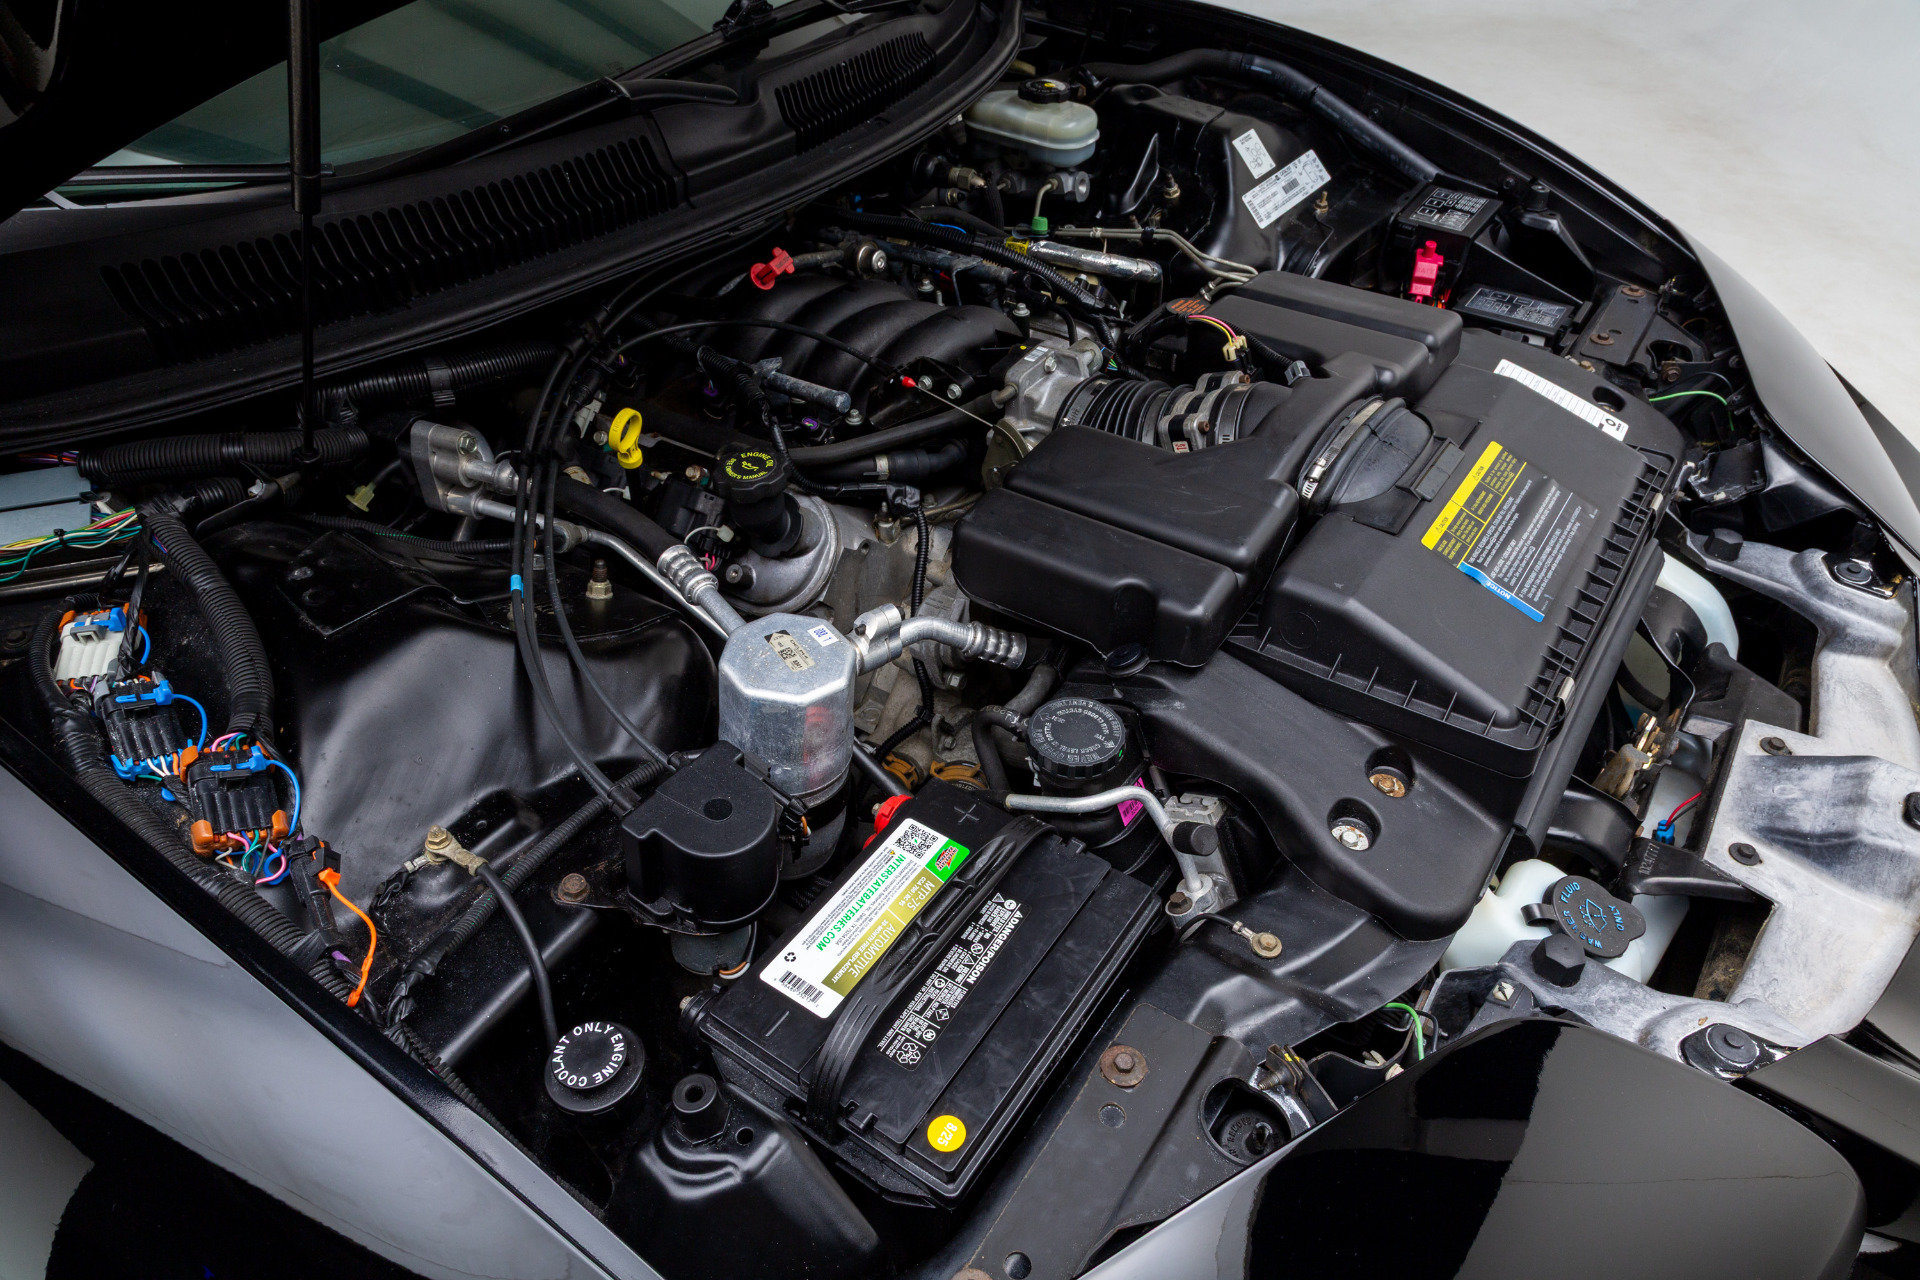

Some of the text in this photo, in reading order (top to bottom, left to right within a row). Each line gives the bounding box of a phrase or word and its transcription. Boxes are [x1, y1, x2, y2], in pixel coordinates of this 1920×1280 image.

[741, 452, 774, 468] ENGINE OIL
[742, 471, 768, 480] MANUAL
[1485, 580, 1511, 599] NOTICE
[915, 875, 926, 886] CCA
[1560, 882, 1581, 904] FLUID
[814, 852, 907, 952] INTERSTATEBATTERIES.COM
[904, 879, 936, 911] MTP-75
[1608, 905, 1625, 932] ONLY
[846, 922, 898, 978] AUTOMOTIVE
[856, 939, 870, 952] FREE
[965, 915, 1019, 984] DANGER/POISON
[829, 950, 861, 984] REPLACEMENT
[552, 1022, 625, 1087] ENGINE COOLANT ONLY
[937, 1122, 956, 1146] 8/25
